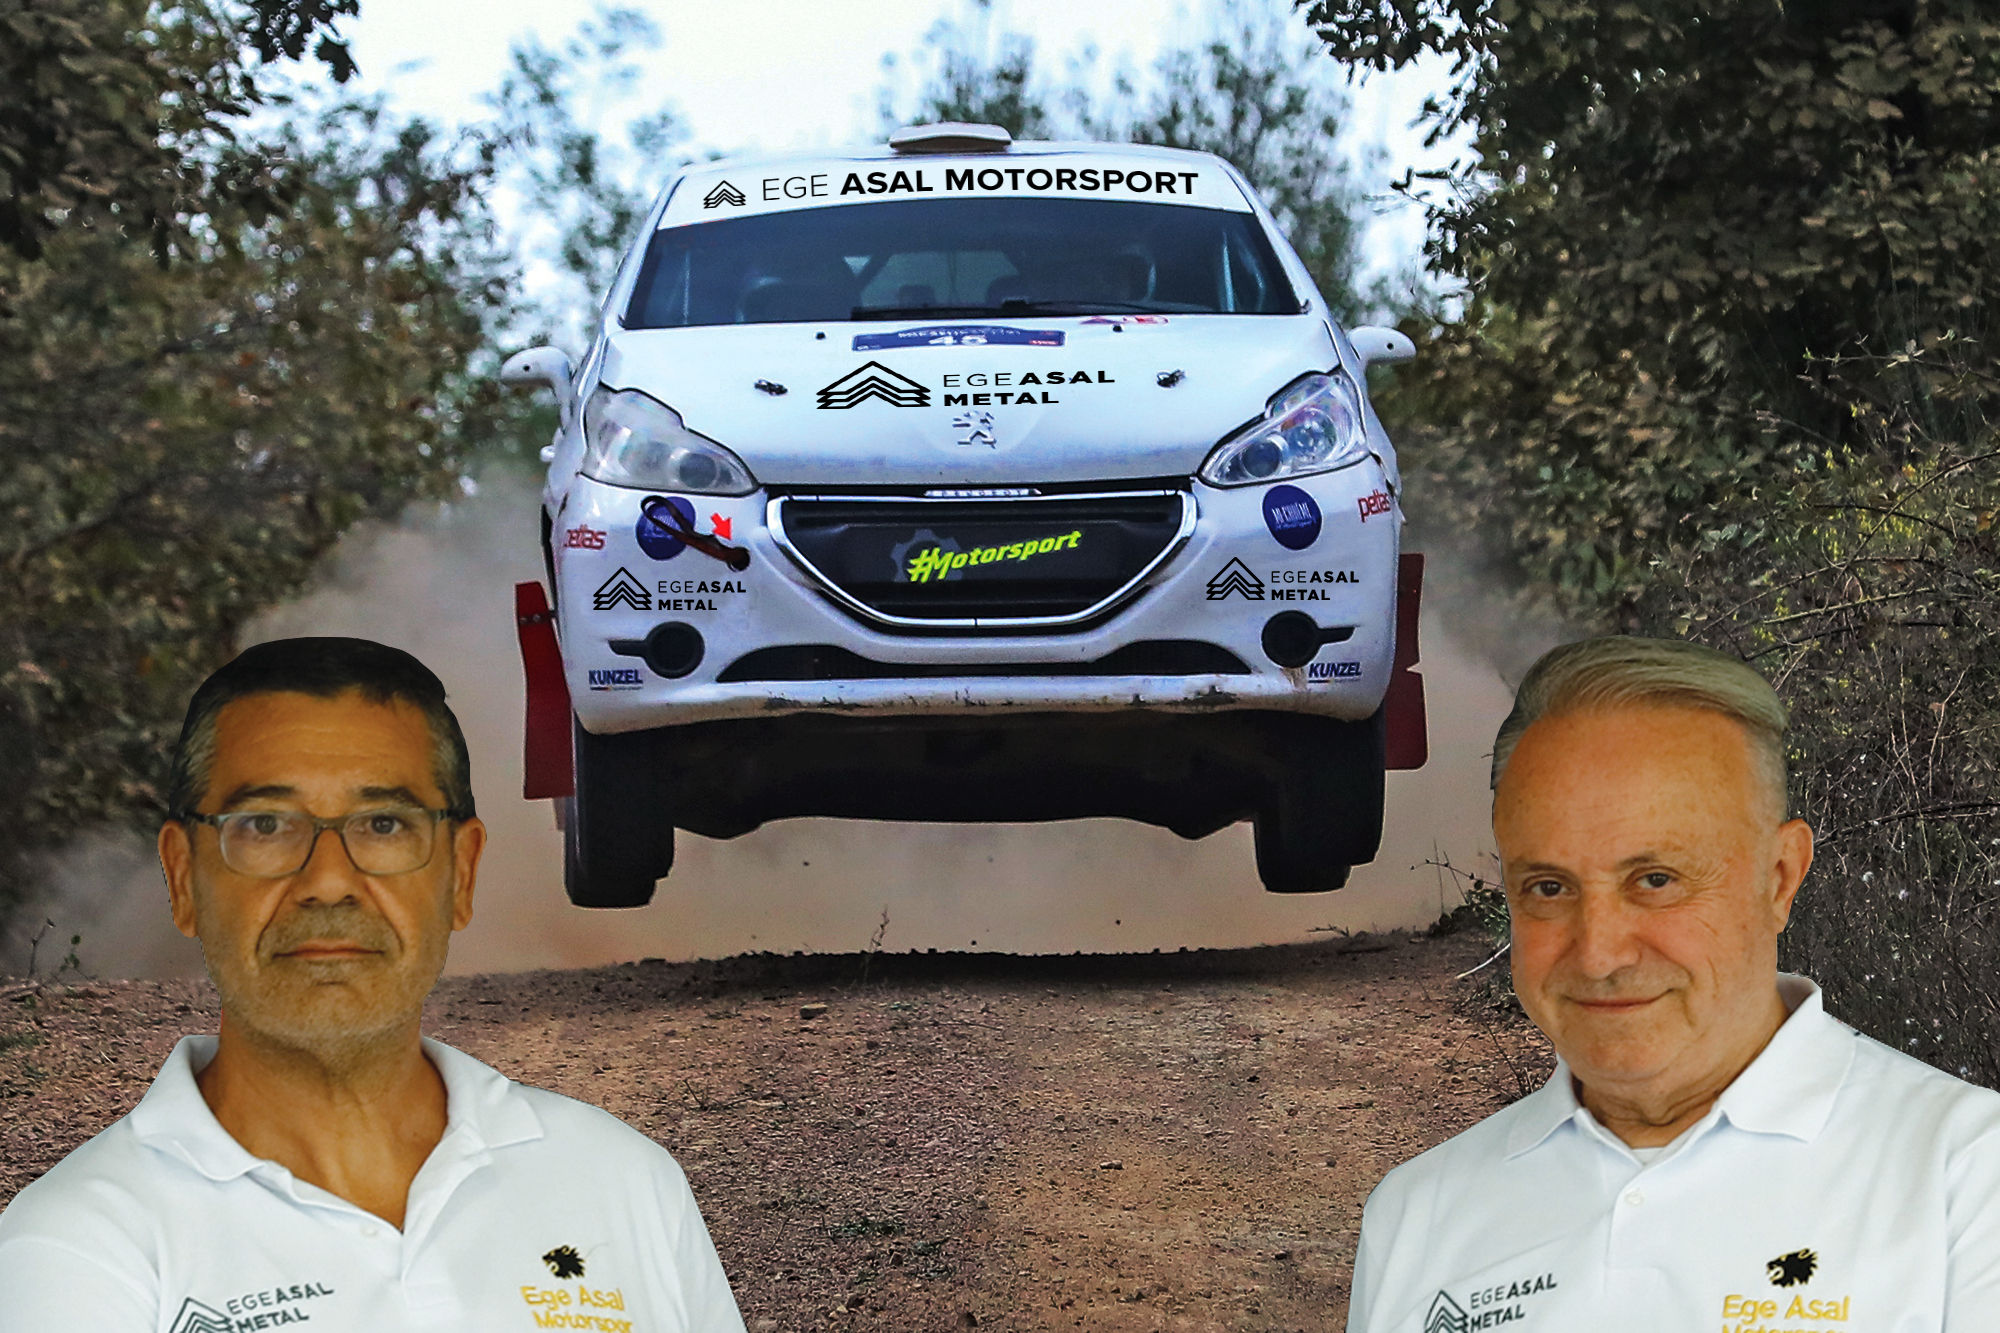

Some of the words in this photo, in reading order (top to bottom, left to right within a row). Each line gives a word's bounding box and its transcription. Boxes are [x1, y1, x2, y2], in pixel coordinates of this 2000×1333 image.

[763, 174, 828, 201] EGE
[840, 170, 933, 196] ASAL
[945, 168, 1199, 195] MOTORSPORT
[943, 391, 1060, 407] METAL
[907, 530, 1082, 584] #Motorsport
[657, 599, 718, 611] METAL
[1270, 588, 1331, 601] METAL
[588, 669, 643, 684] KUNZEL
[1309, 662, 1362, 678] KUNZEL
[520, 1286, 573, 1311] Ege
[579, 1285, 625, 1312] Asal
[1722, 1294, 1778, 1325] Ege
[1784, 1294, 1850, 1322] Asal
[235, 1307, 309, 1333] METAL
[1470, 1304, 1525, 1333] METAL
